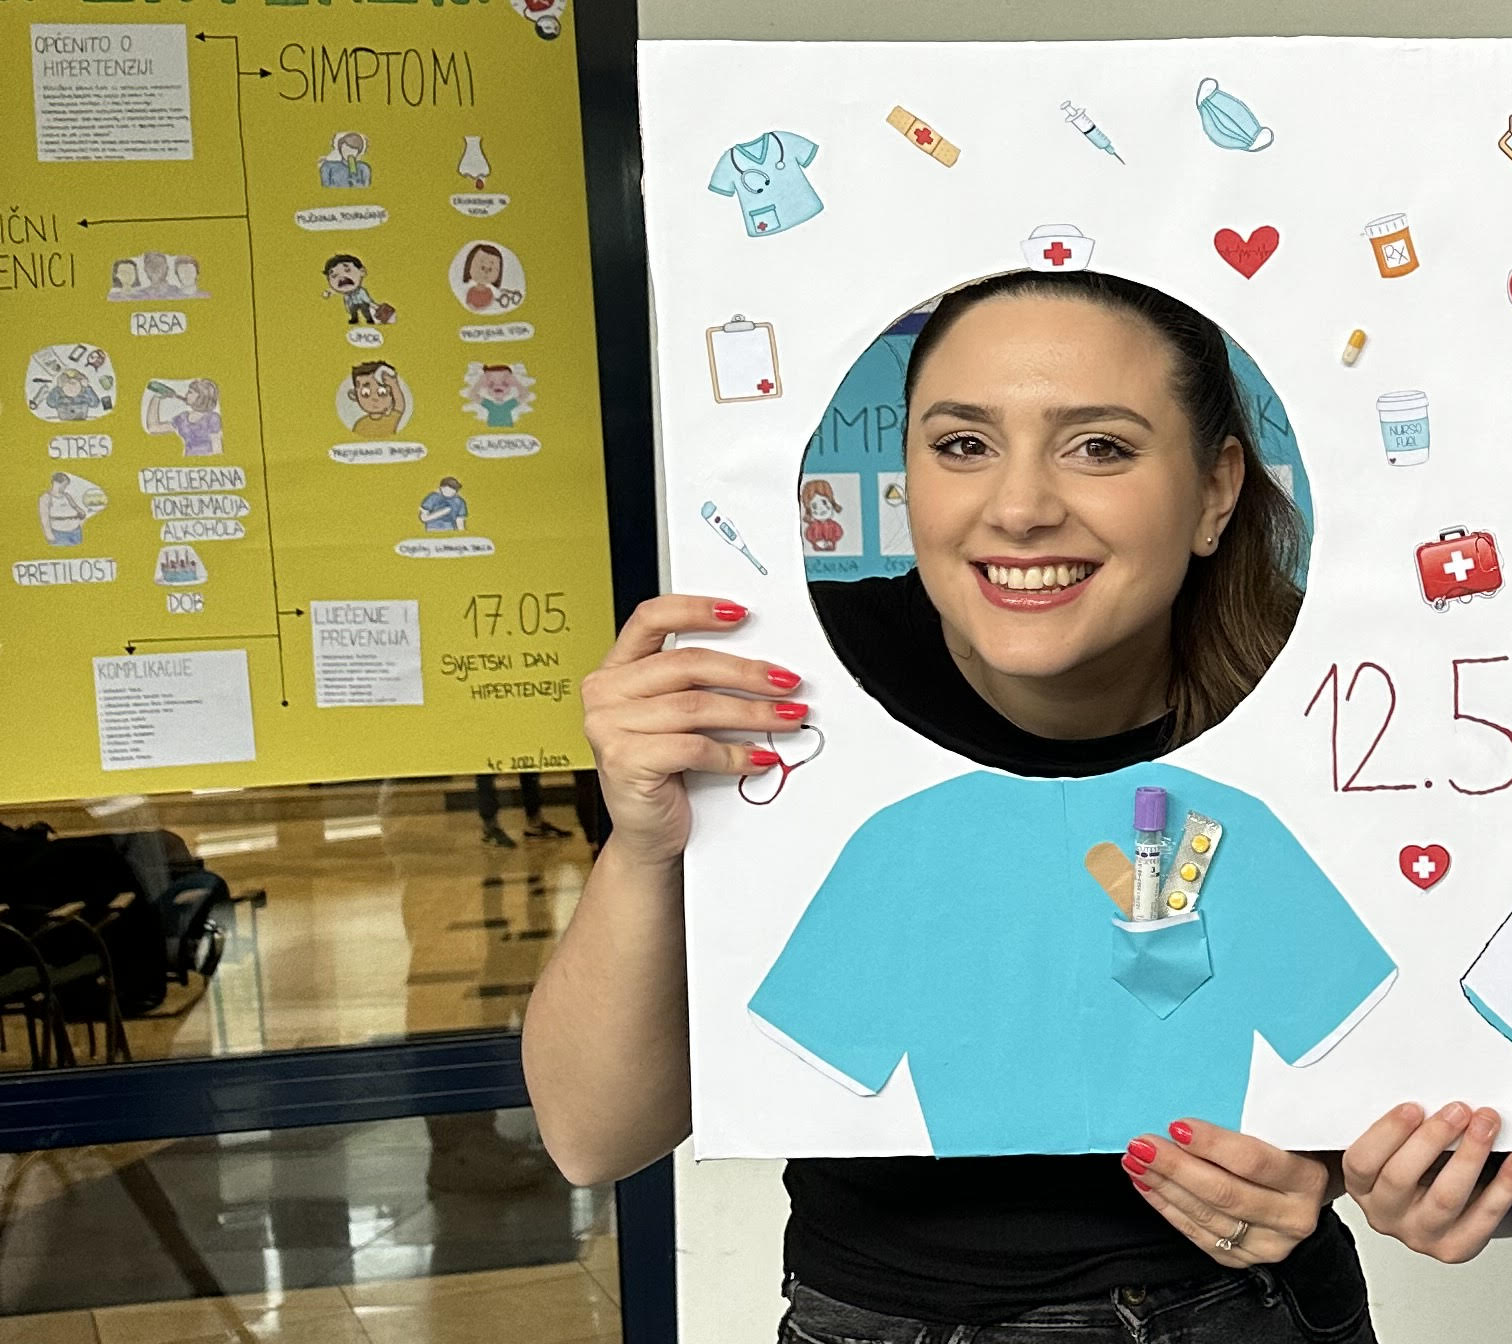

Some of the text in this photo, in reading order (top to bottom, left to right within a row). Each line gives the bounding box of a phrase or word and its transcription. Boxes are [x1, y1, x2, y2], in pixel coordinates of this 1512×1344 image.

[43, 59, 153, 77] HIPERTENZIJI
[279, 43, 475, 106] SIMPTOMI
[135, 314, 183, 334] RASA
[50, 436, 110, 458] STRES
[142, 468, 243, 493] PRETJERANA
[164, 520, 245, 540] ALKOHOLA
[15, 559, 117, 583] PRETILOST
[404, 607, 408, 624] I
[464, 592, 570, 639] 17.05.
[319, 628, 409, 647] PREVENCIJA
[97, 658, 193, 680] KOMPLIKACIJE
[441, 651, 560, 681] SVJETSKI DAN
[471, 678, 572, 702] HIPERTENZIJE
